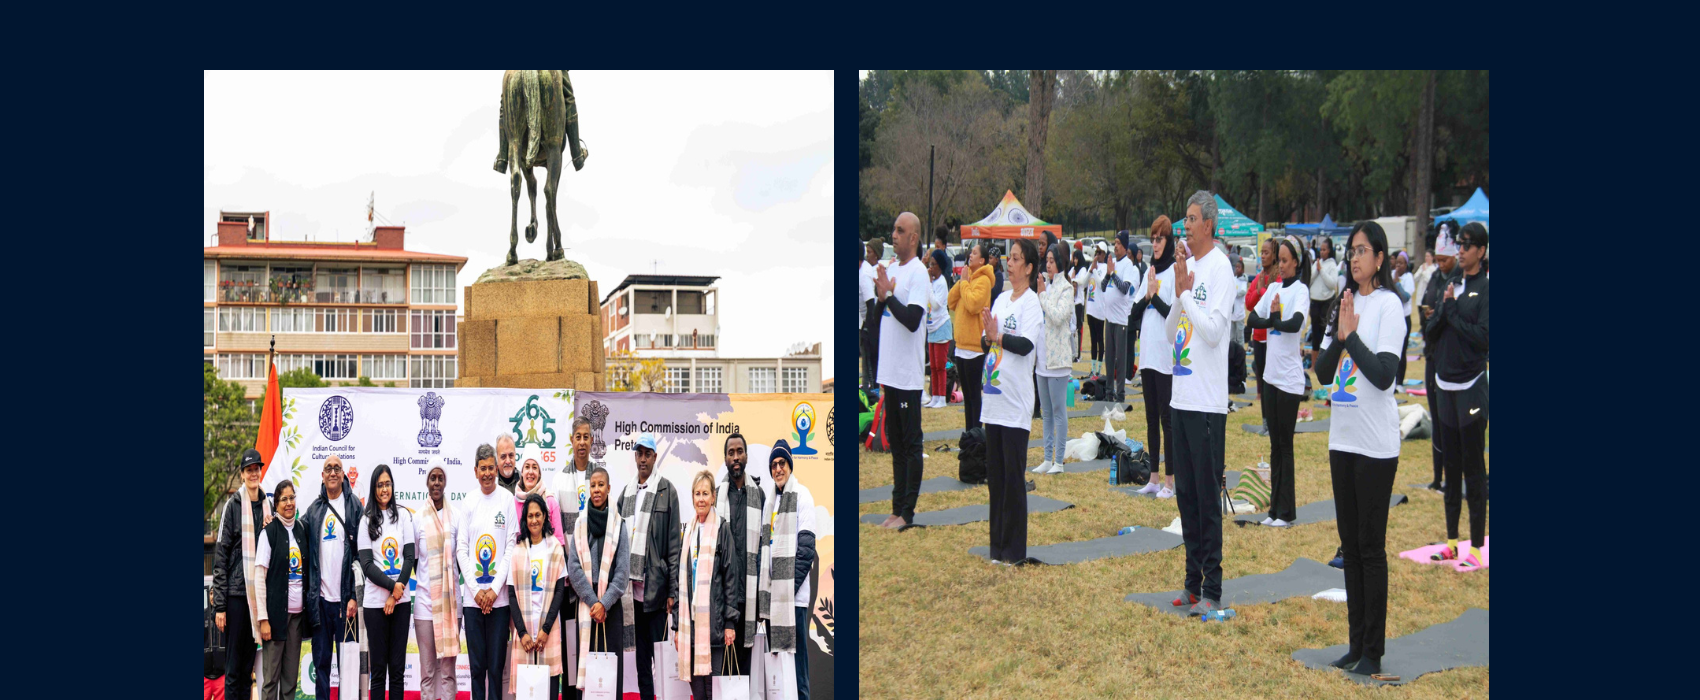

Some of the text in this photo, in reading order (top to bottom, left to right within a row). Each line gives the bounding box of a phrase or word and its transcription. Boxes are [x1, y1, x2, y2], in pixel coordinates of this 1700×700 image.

[615, 421, 740, 435] High Commission of India
[614, 439, 637, 451] Pret
[393, 457, 406, 466] High
[446, 458, 462, 466] India,
[541, 451, 556, 462] 65
[450, 492, 467, 500] DAY
